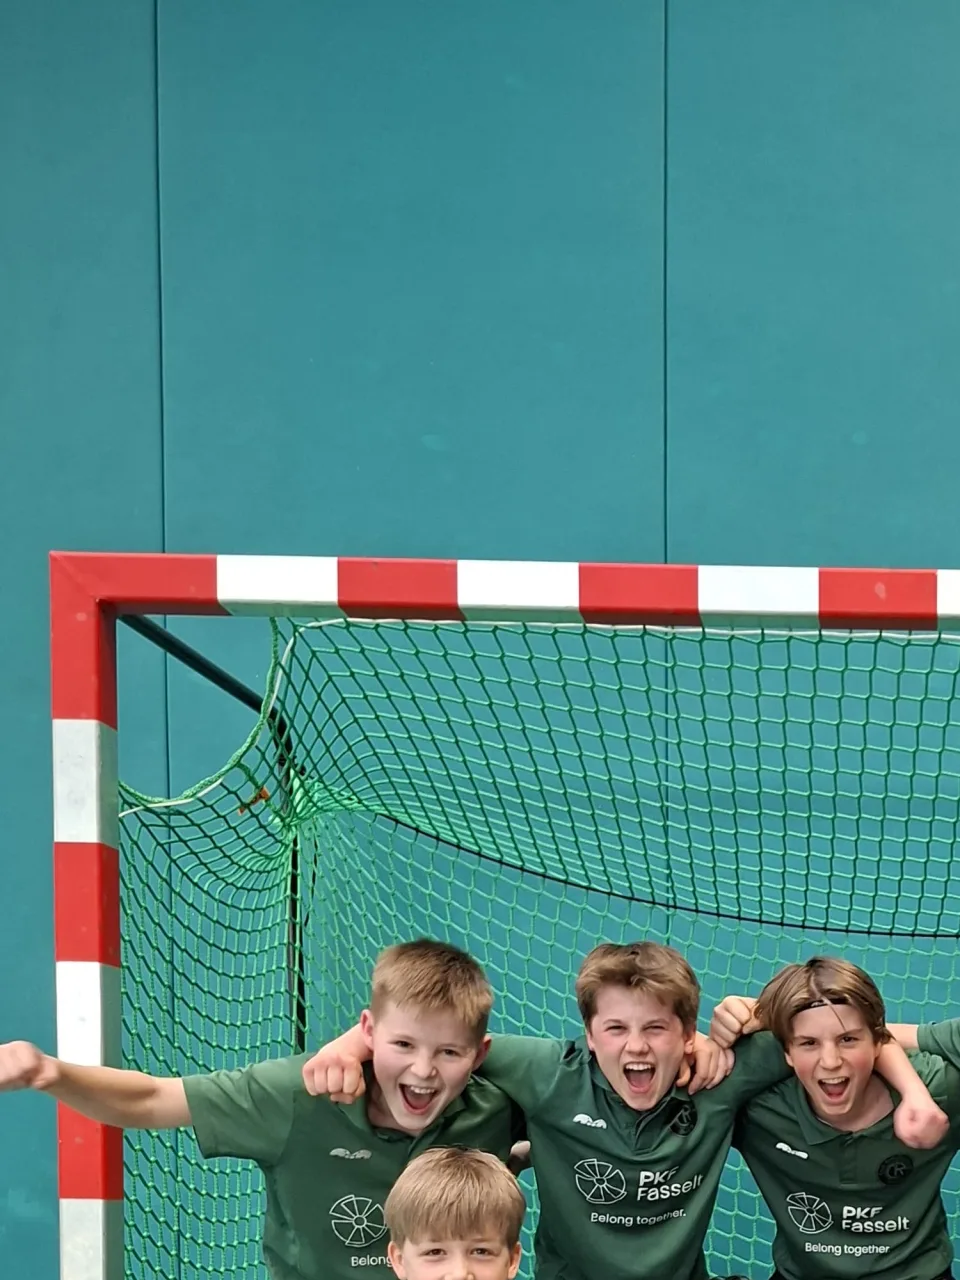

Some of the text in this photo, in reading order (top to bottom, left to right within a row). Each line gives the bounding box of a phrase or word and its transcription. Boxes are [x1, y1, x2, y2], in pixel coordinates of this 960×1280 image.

[638, 1165, 679, 1187] PKF
[636, 1174, 703, 1202] Fasselt
[590, 1208, 687, 1227] Belong together.
[842, 1205, 883, 1219] PKF
[841, 1215, 911, 1233] Fasselt
[804, 1242, 842, 1256] Belong
